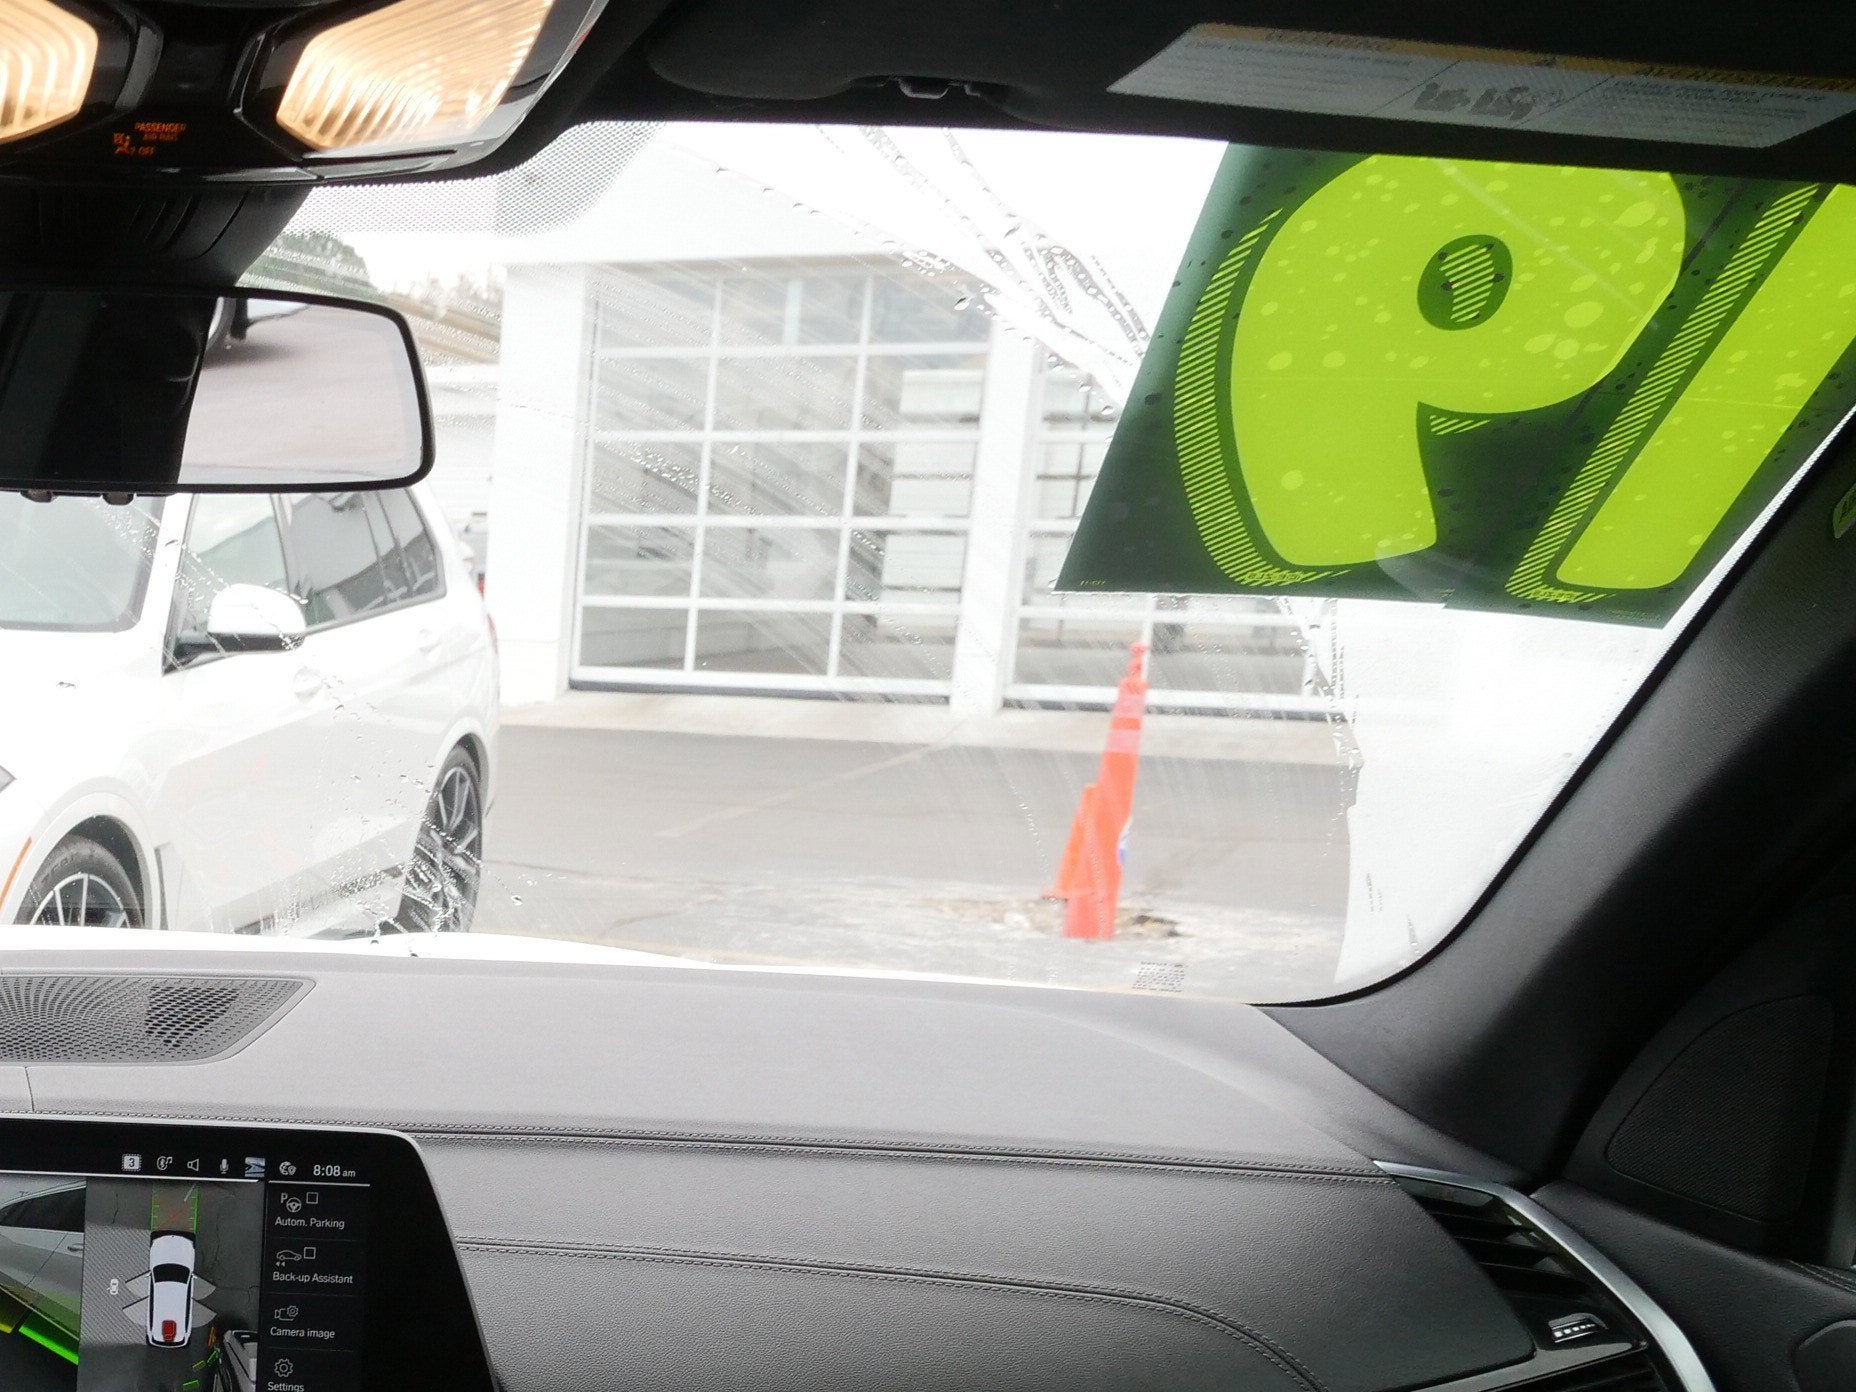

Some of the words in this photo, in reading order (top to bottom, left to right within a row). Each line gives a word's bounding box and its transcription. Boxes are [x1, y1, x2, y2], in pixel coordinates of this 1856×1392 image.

[313, 1164, 341, 1177] 8:08
[342, 1169, 356, 1178] am
[275, 1216, 308, 1227] Autom.
[310, 1218, 345, 1229] Parking
[273, 1271, 310, 1283] Back-up
[312, 1273, 353, 1284] Assistant
[270, 1326, 305, 1337] Camera
[307, 1328, 335, 1339] image
